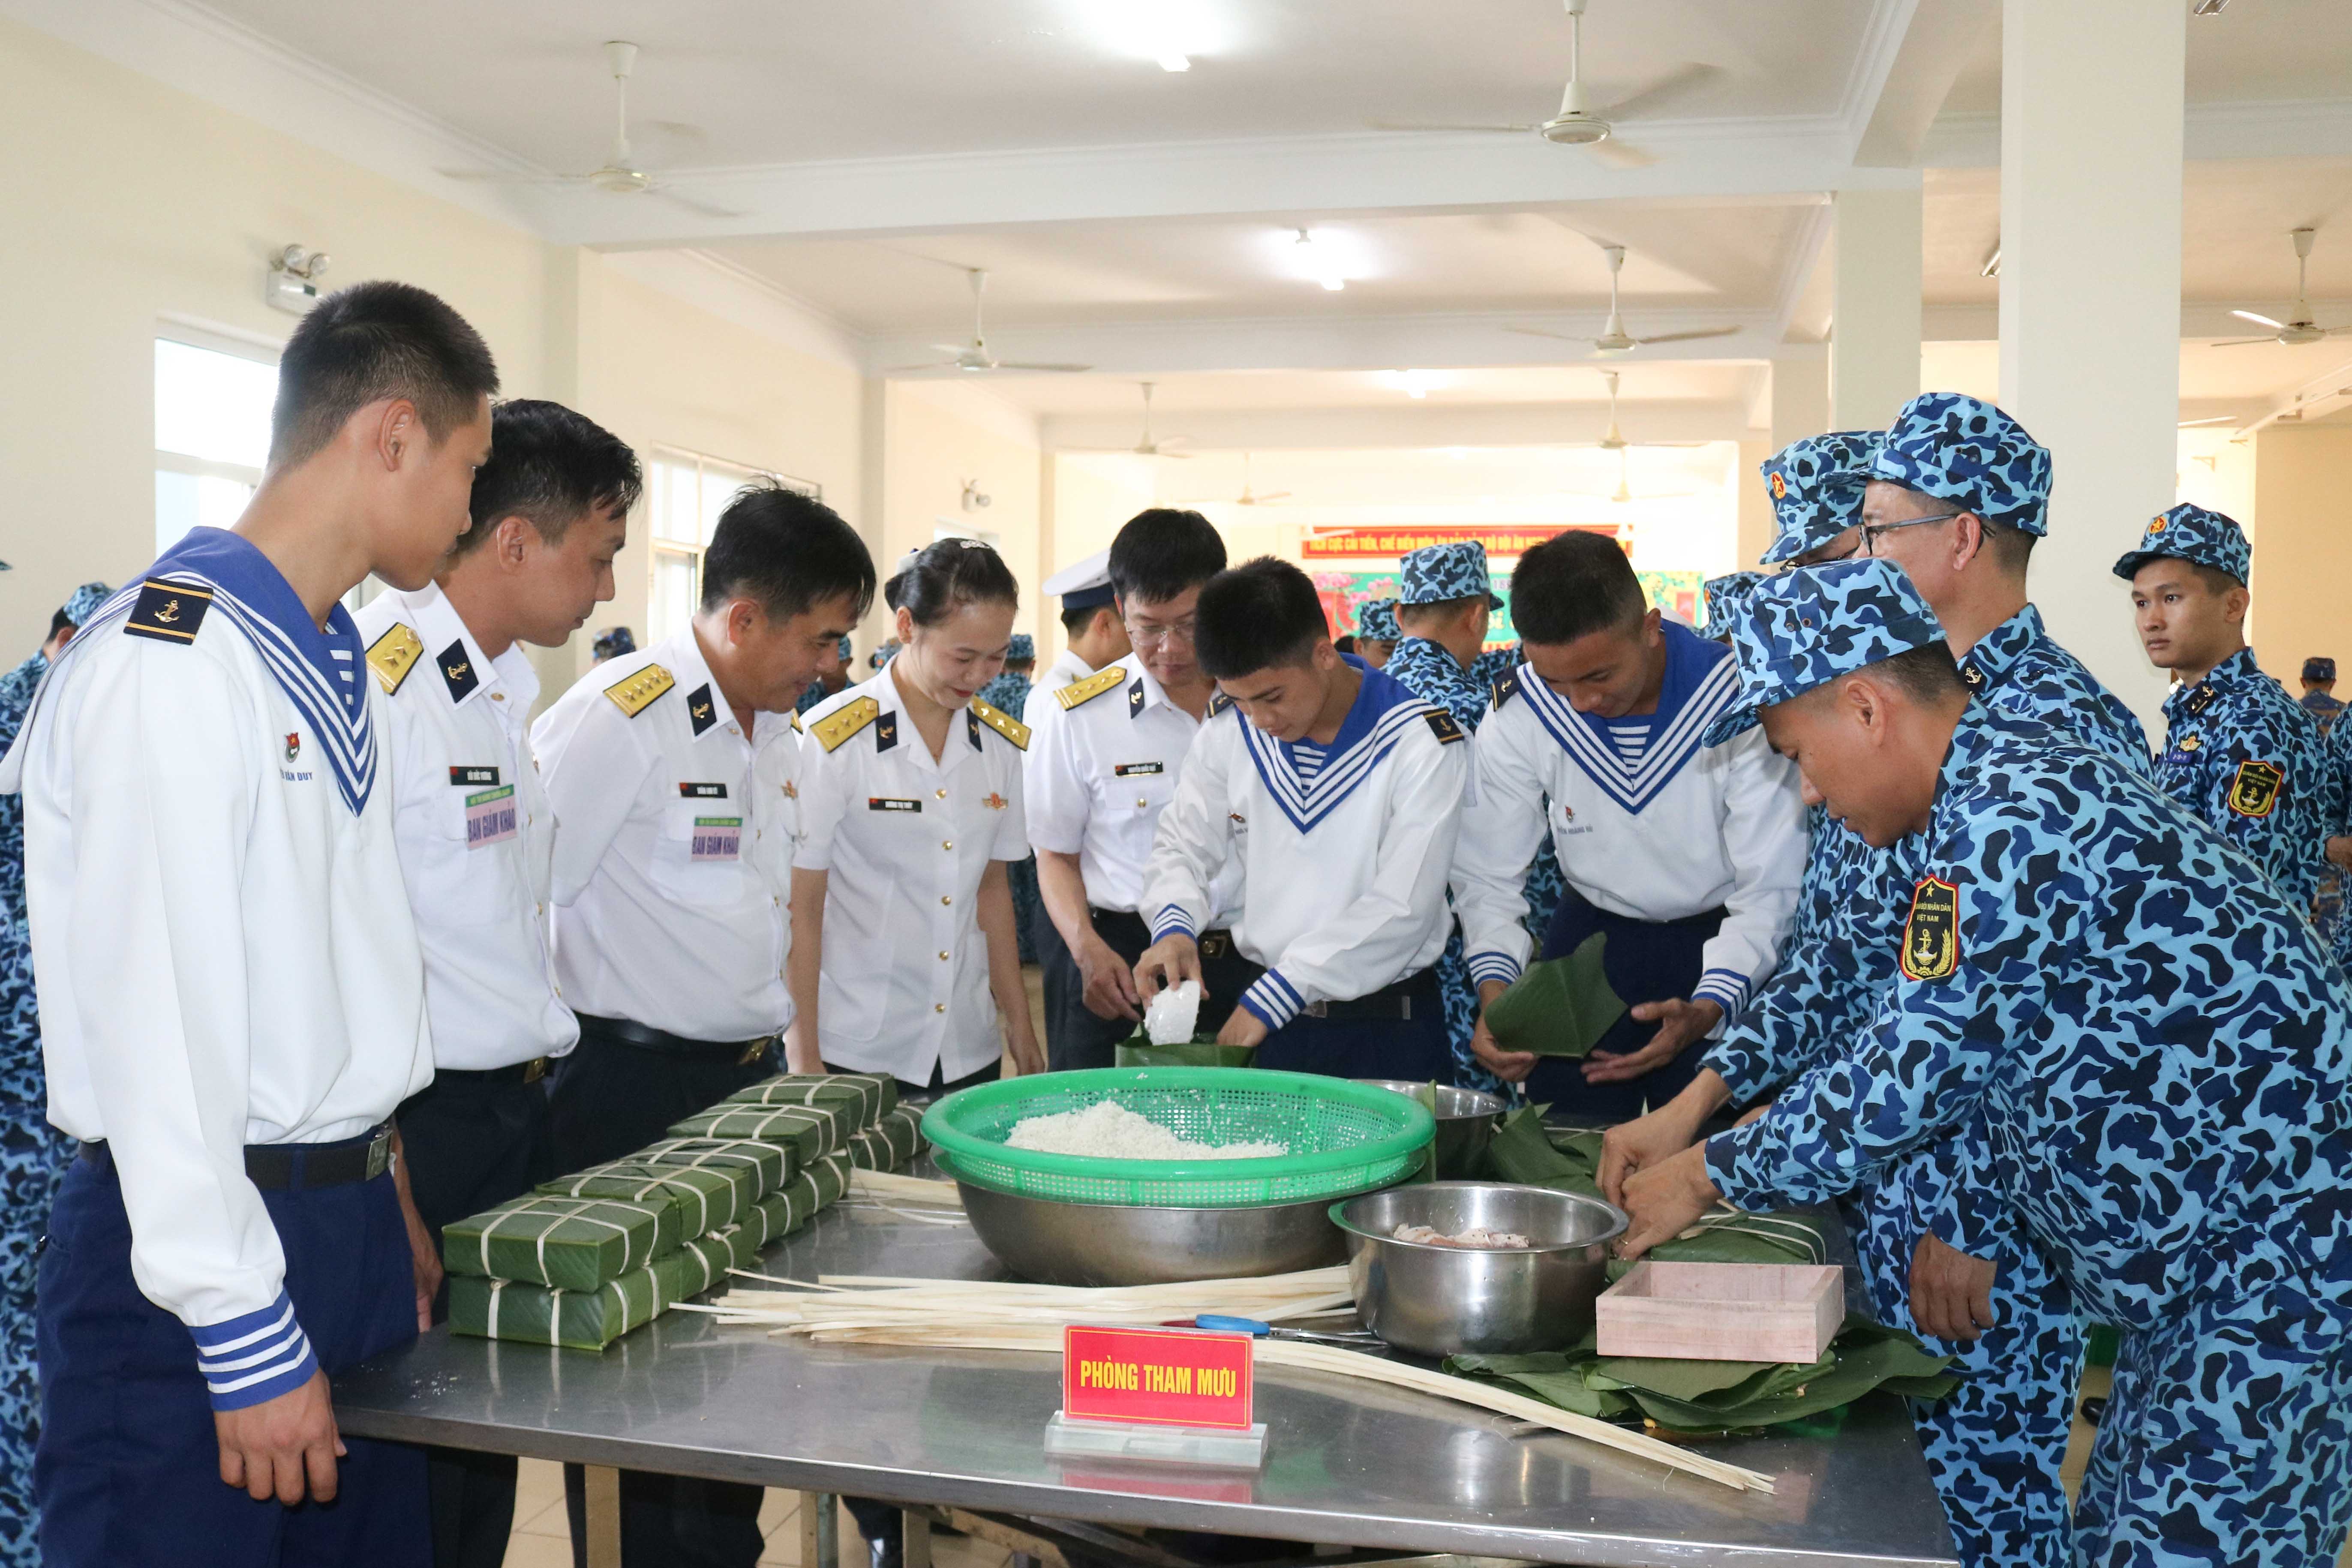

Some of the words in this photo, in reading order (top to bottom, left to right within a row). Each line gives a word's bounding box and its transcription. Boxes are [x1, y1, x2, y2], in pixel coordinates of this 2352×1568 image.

[297, 772, 312, 781] DUY
[1927, 901, 1940, 911] NHÂN
[1940, 903, 1951, 912] DÂN
[1916, 913, 1926, 922] VIỆT
[1081, 1355, 1138, 1391] PHÒNG
[1144, 1364, 1191, 1394] THAM
[1197, 1367, 1236, 1397] MƯU
